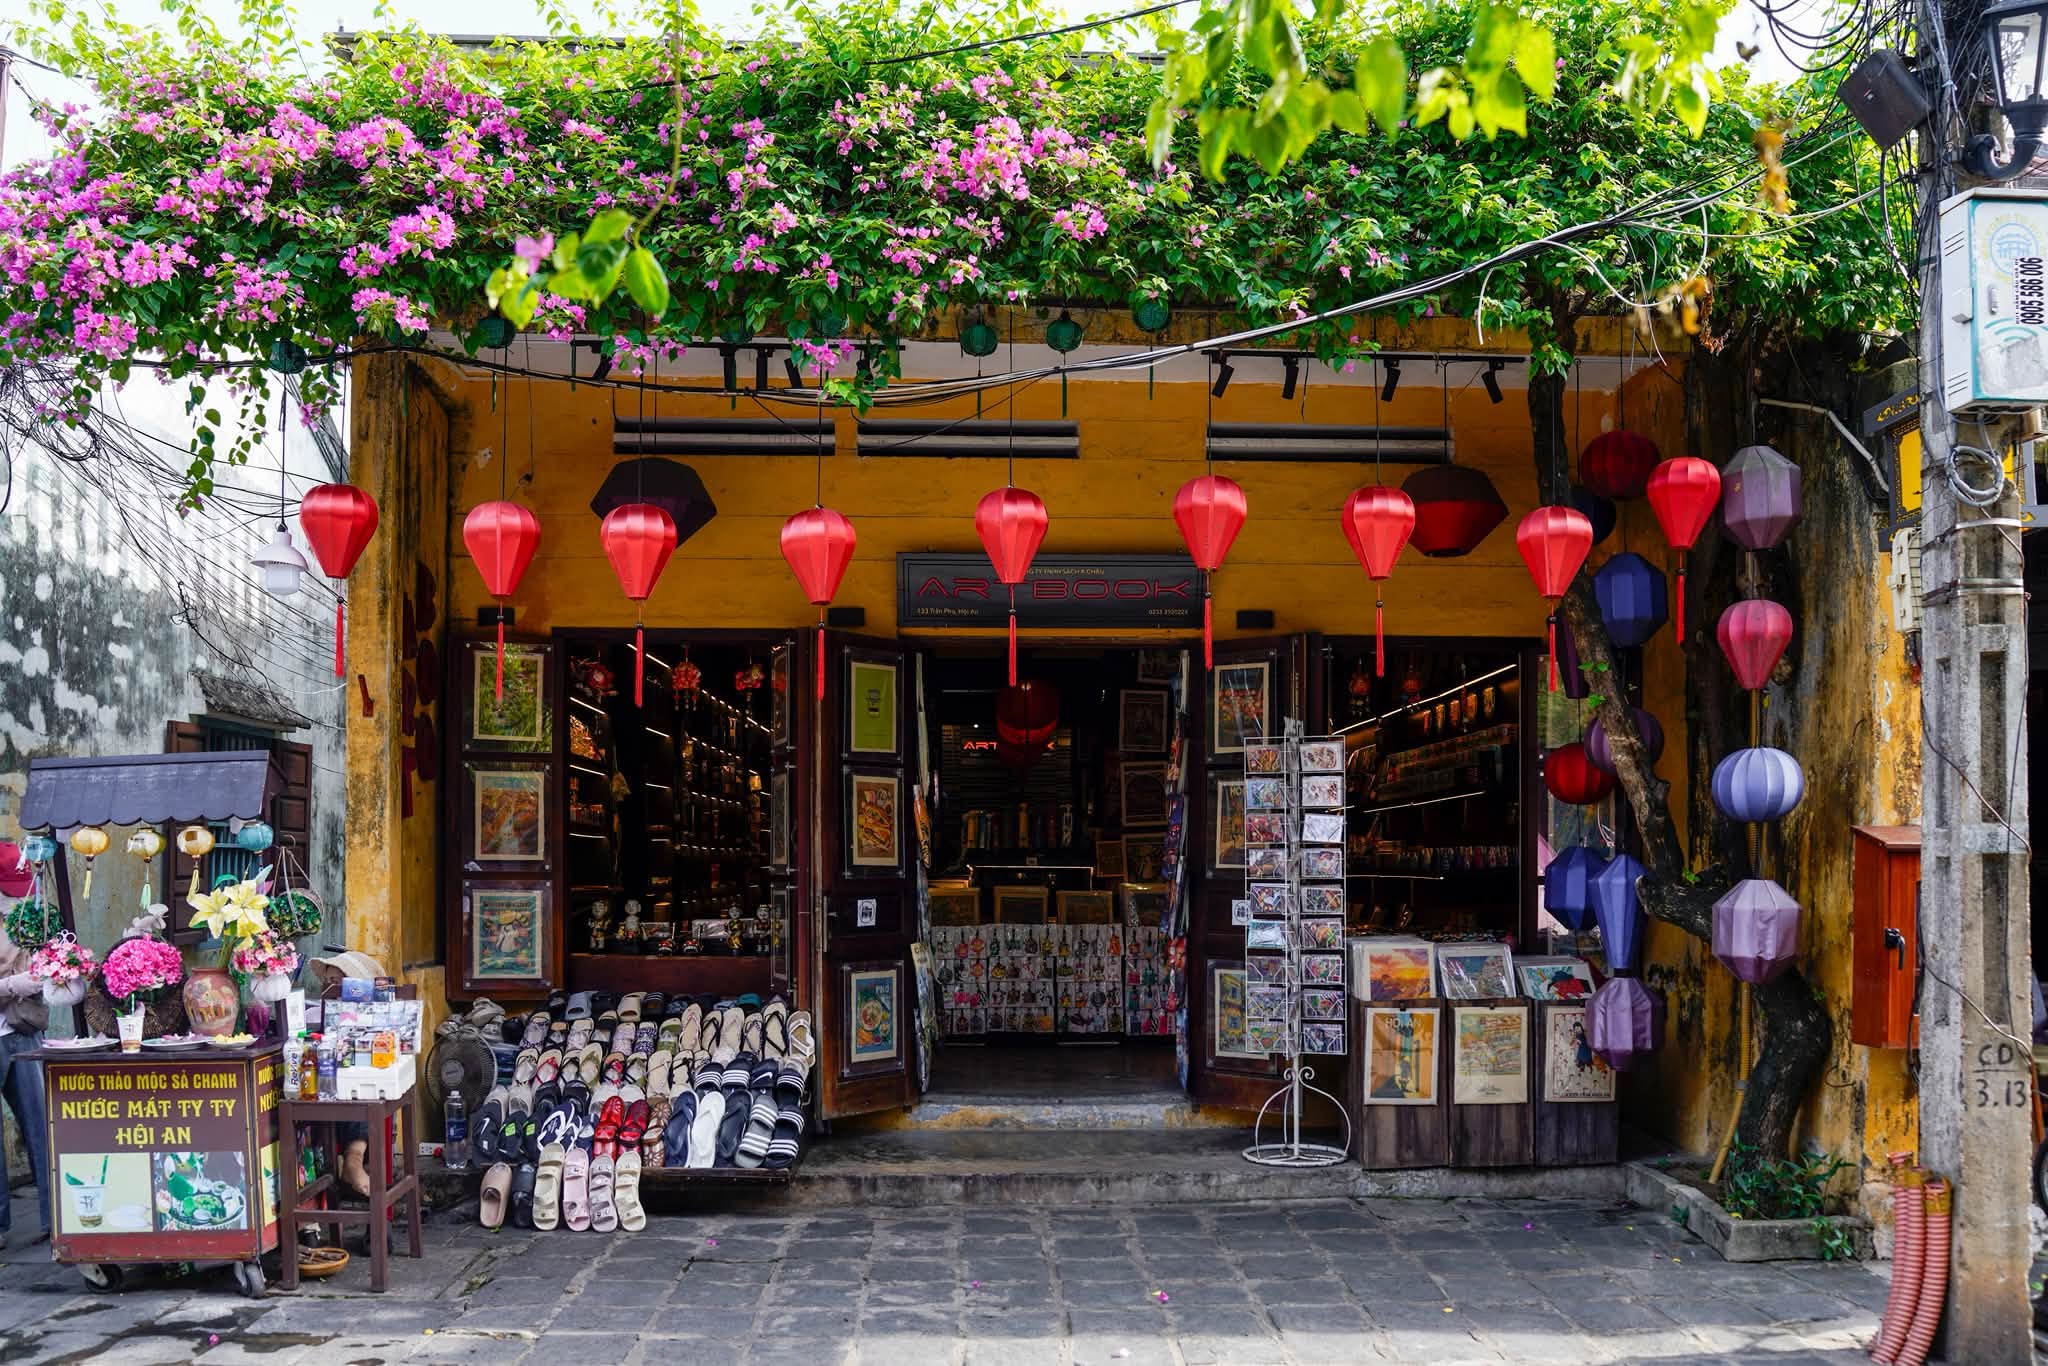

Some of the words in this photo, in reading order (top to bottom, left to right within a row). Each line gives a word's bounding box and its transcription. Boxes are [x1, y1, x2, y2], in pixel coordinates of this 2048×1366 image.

[2019, 257, 2045, 325] 0905.586.006
[1032, 579, 1191, 600] BOOK
[1978, 1043, 2014, 1065] CD
[59, 1072, 95, 1091] NƯỚC
[98, 1070, 132, 1090] THẢO
[136, 1071, 169, 1093] MỘC
[193, 1073, 237, 1089] CHANH
[1976, 1079, 2027, 1108] 3.13
[61, 1097, 120, 1120] NƯỚC
[127, 1098, 172, 1119] MÁT
[178, 1099, 205, 1118] TY
[210, 1098, 236, 1118] TY
[115, 1123, 155, 1149] HỘI
[161, 1126, 192, 1145] AN
